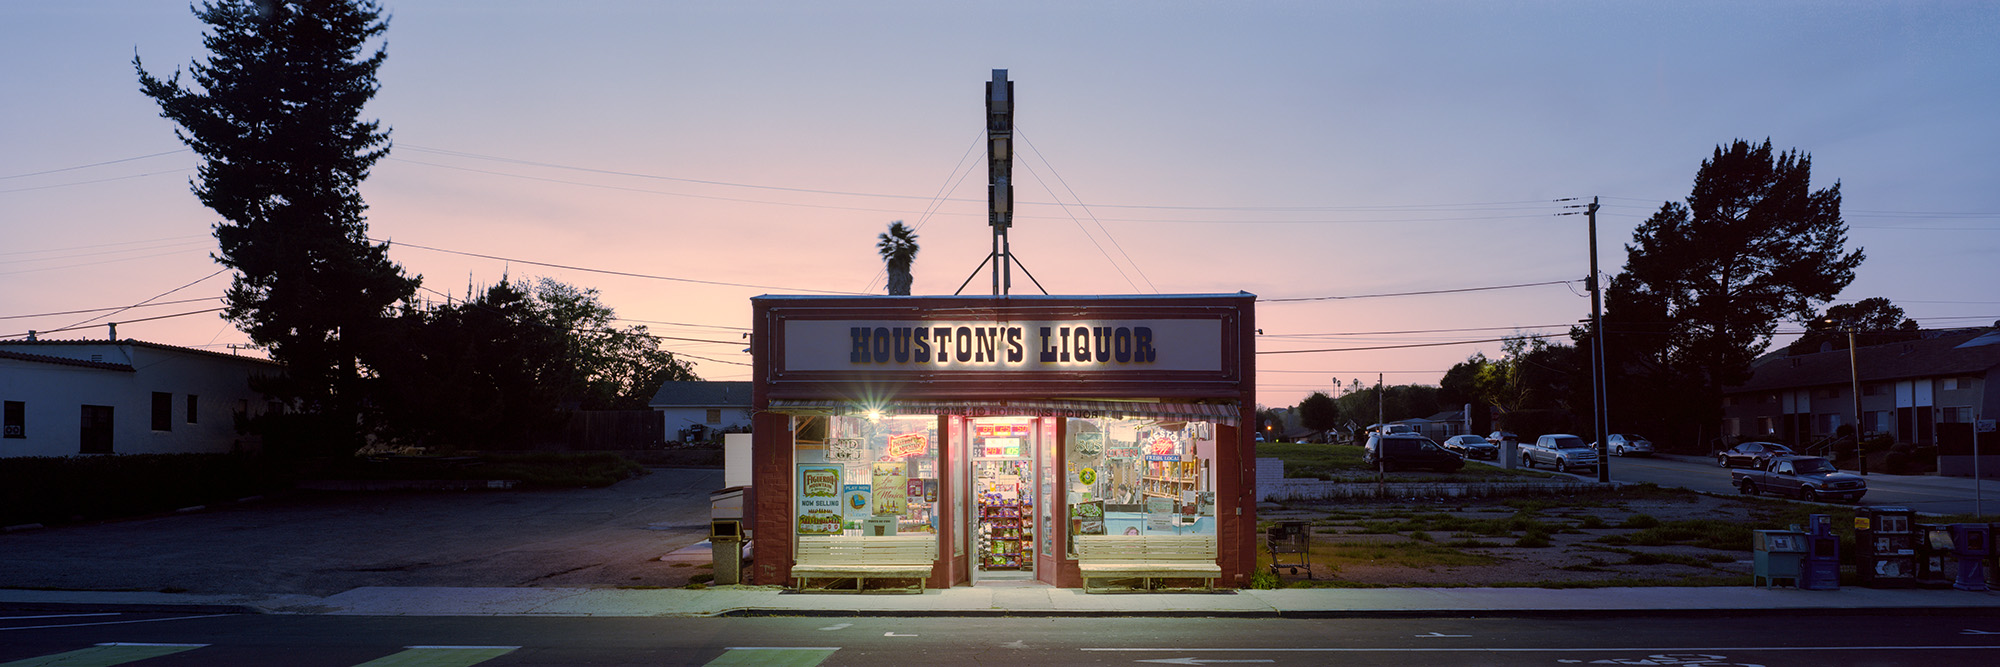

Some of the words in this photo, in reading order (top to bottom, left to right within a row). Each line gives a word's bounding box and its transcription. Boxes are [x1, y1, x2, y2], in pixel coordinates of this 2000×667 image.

[850, 326, 1023, 363] HOUSTON'S
[1039, 326, 1157, 363] LIQUOR
[911, 406, 967, 415] WELCOME
[972, 407, 986, 416] TO
[1056, 408, 1099, 419] LIQUOR
[1107, 448, 1138, 457] OPEN
